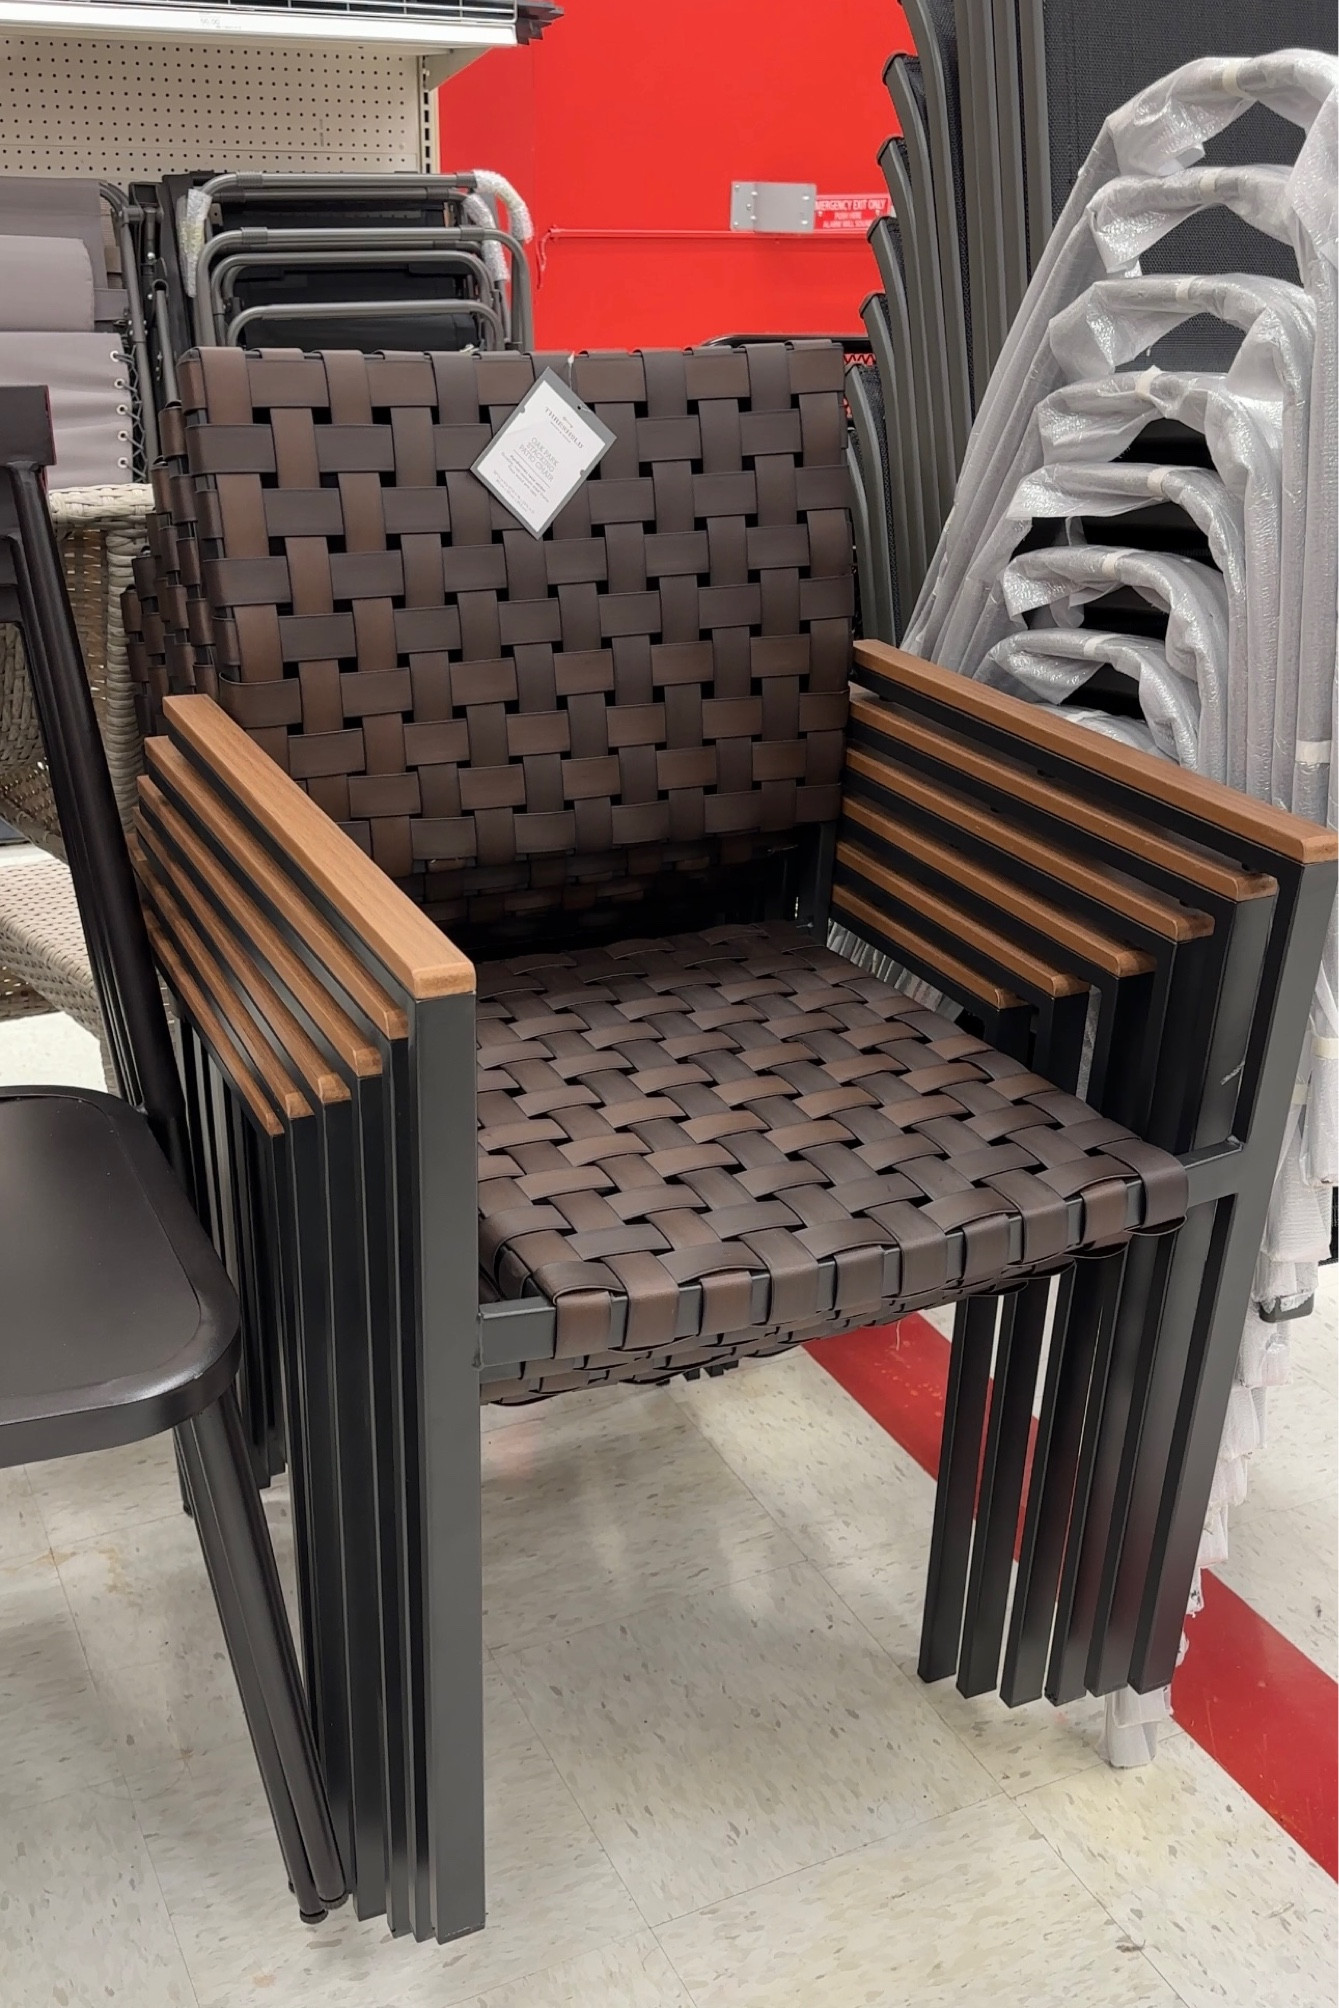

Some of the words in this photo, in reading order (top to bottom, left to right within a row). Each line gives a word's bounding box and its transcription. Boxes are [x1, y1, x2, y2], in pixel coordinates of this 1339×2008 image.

[815, 200, 852, 211] MERGENCY
[853, 199, 867, 210] EXIT
[868, 199, 886, 210] ONLY
